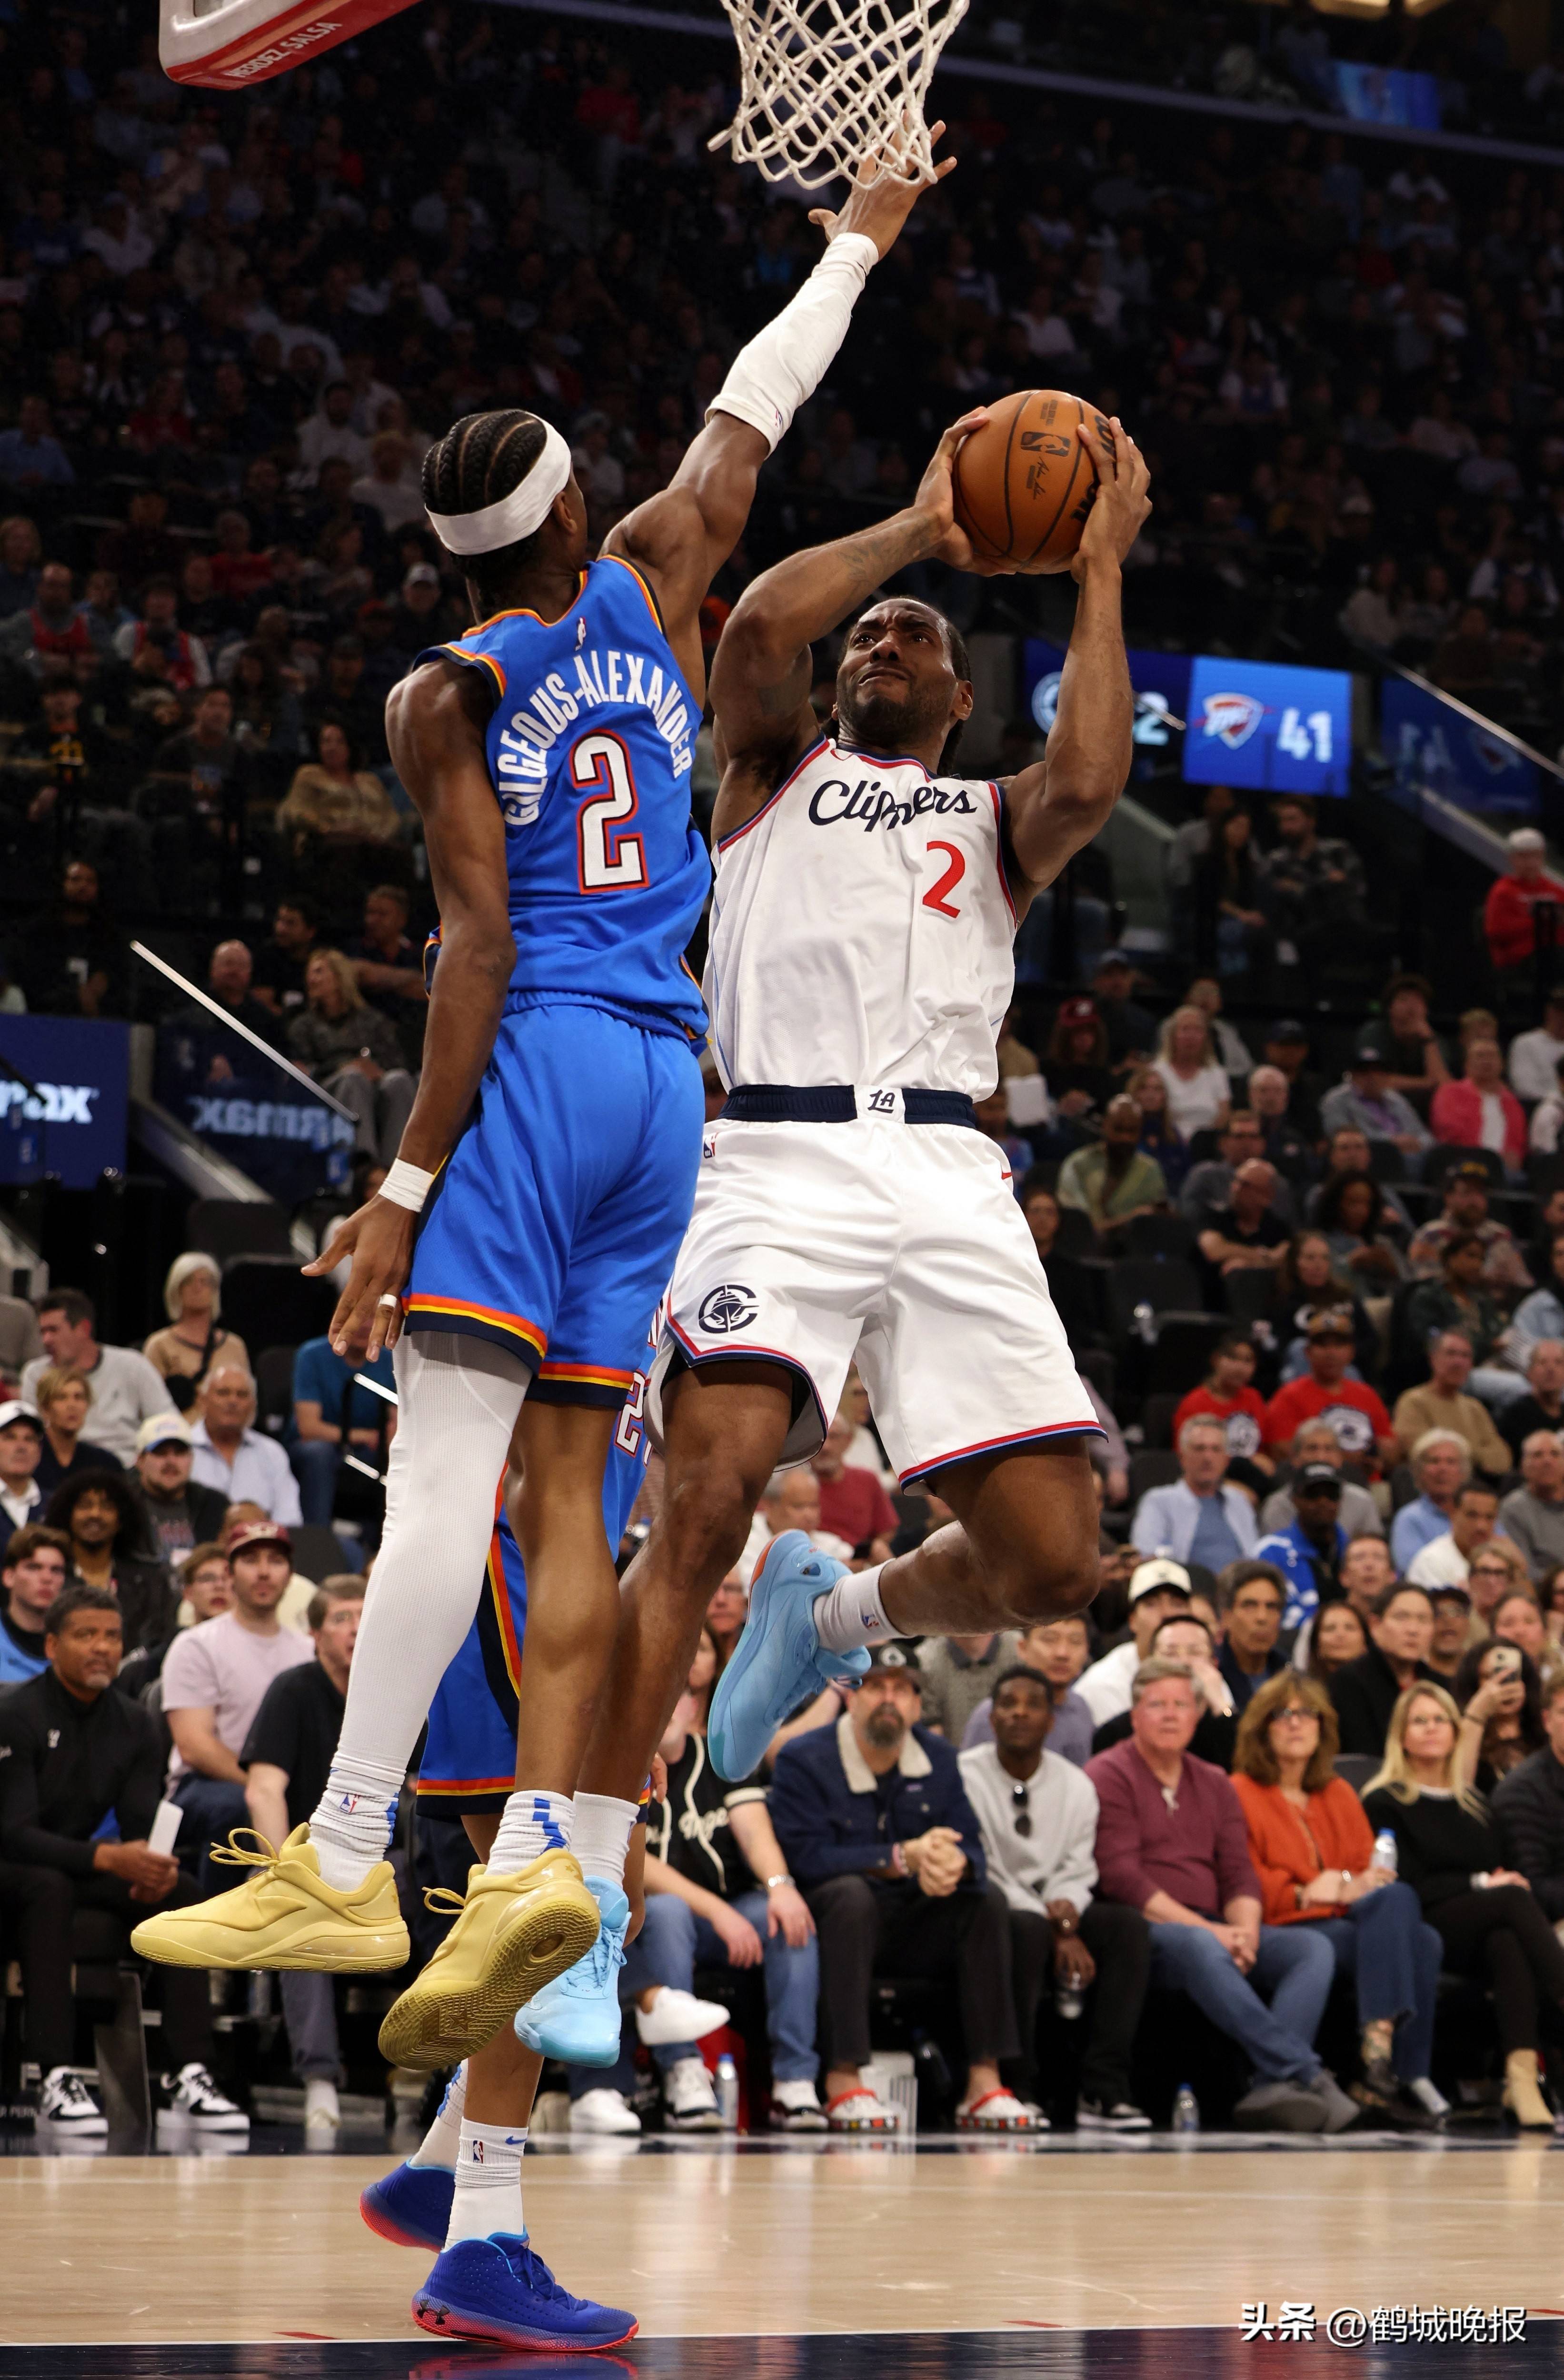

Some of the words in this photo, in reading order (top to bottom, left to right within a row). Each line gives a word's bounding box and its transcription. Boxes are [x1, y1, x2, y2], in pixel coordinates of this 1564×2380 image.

[219, 49, 291, 78] HERDEZ
[280, 22, 343, 49] SALSA
[498, 650, 692, 826] GILGEOUS-ALEXANDER
[1276, 707, 1333, 763] 41
[570, 729, 648, 894] 2
[808, 780, 977, 833] Clippers
[922, 840, 966, 919] 2
[867, 1089, 896, 1114] LA
